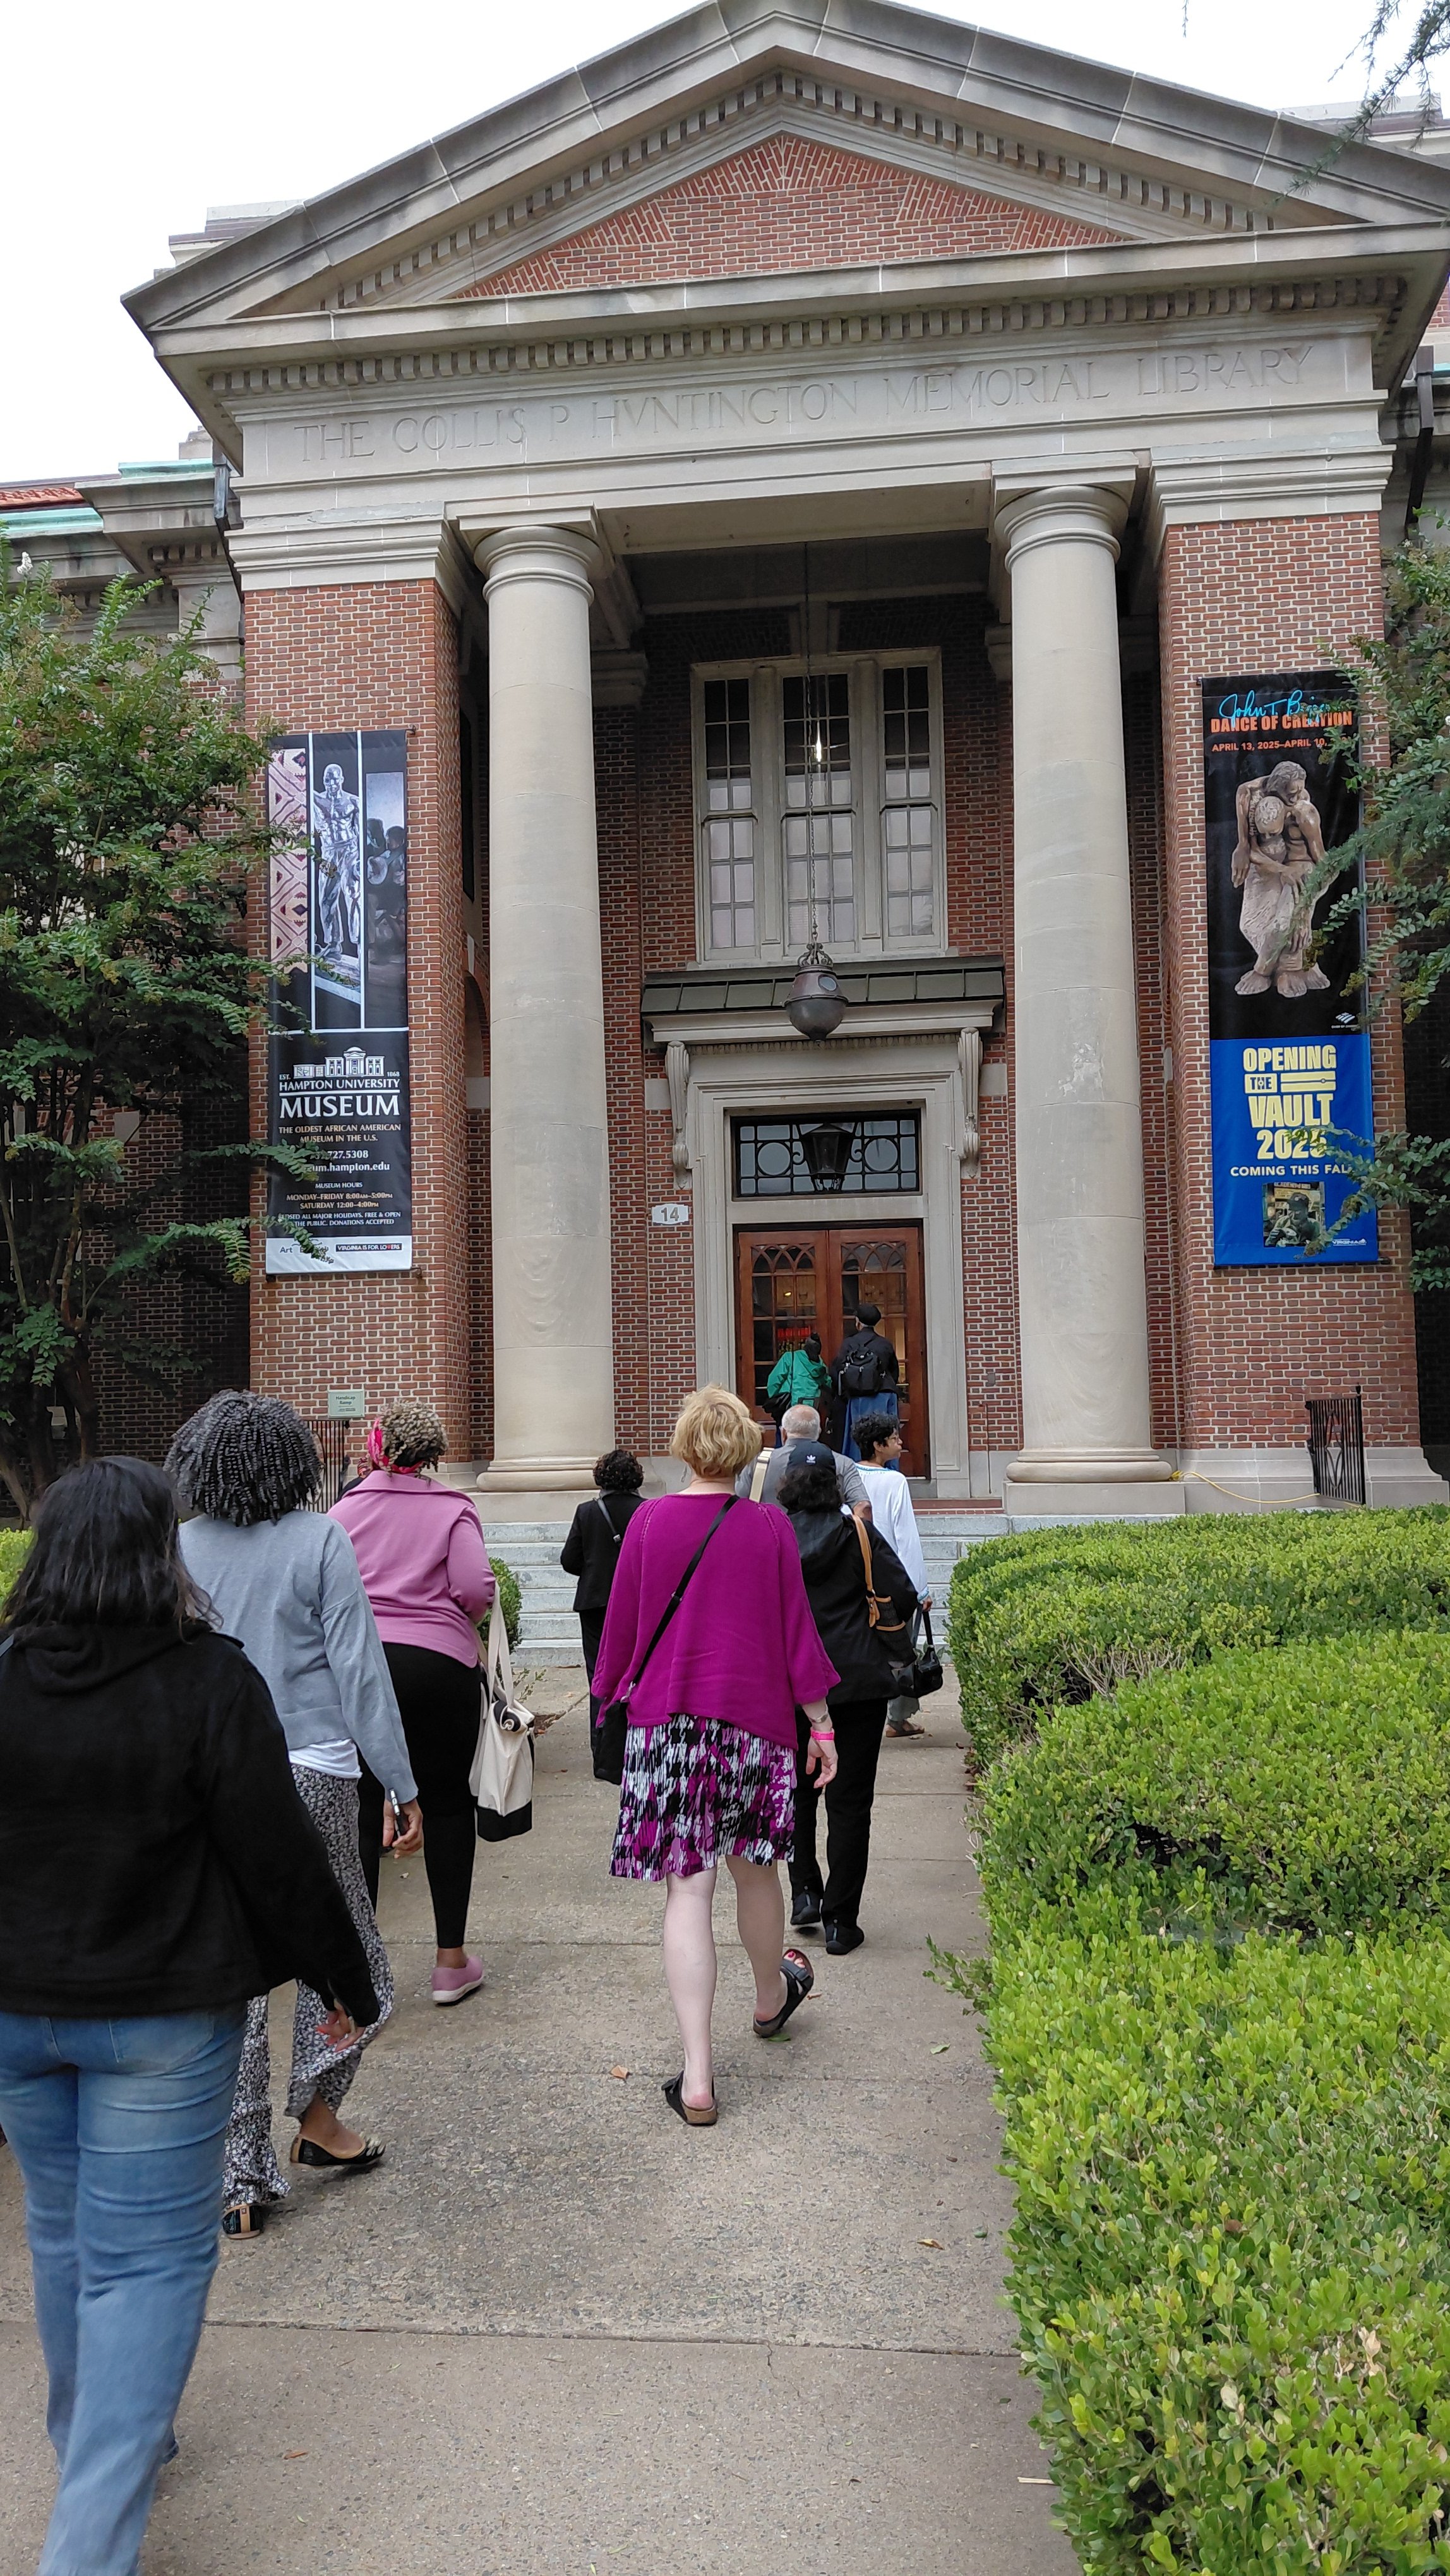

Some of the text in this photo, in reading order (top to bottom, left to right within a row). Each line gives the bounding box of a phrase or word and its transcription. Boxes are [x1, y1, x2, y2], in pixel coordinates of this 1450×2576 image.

[294, 420, 375, 462] THE
[392, 407, 526, 453] COLLIS
[549, 405, 570, 443] P
[885, 361, 1111, 415] MEMORIAL
[1137, 345, 1315, 396] LIBRARY
[1219, 689, 1266, 728] John
[1211, 710, 1353, 733] DANCE OF CREATION
[1211, 742, 1239, 752] APRIL
[1240, 742, 1255, 751] 13,
[1243, 1044, 1337, 1072] OPENING
[279, 1078, 400, 1091] HAMPTON UNIVERSITY
[1249, 1076, 1273, 1090] THE
[279, 1095, 400, 1118] MUSEUM
[1248, 1093, 1334, 1128] VAULT
[295, 1125, 323, 1133] OLDEST
[1256, 1128, 1327, 1159] 2025
[302, 1161, 390, 1174] um.hampton.edu
[1230, 1166, 1286, 1177] COMING
[1290, 1164, 1319, 1175] THIS
[661, 1207, 680, 1222] 14
